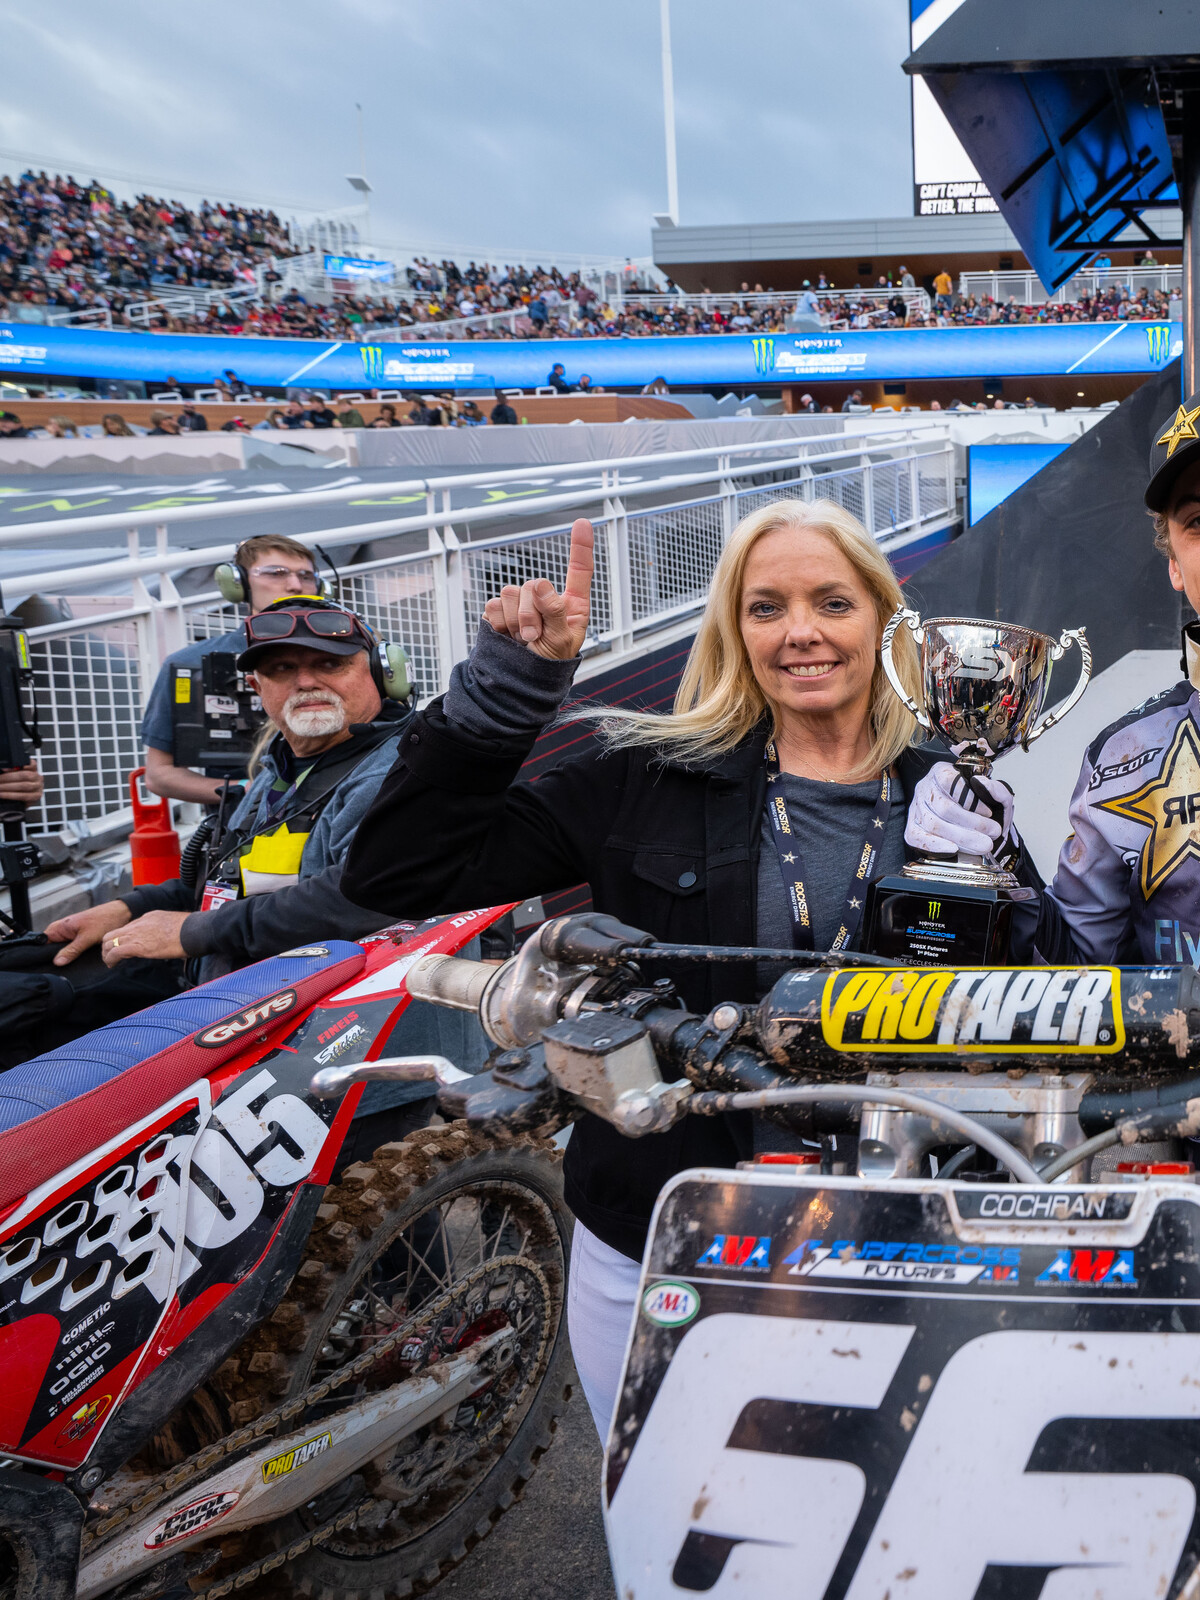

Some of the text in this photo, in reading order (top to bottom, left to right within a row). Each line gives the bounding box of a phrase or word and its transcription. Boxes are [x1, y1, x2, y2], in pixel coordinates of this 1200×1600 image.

[1104, 749, 1160, 777] SCOTT
[775, 797, 791, 836] ROCKSTAR
[856, 842, 873, 880] ROCKSTAR
[794, 881, 810, 928] ROCKSTAR
[927, 945, 949, 953] Futures
[202, 992, 294, 1042] GUTS
[317, 1010, 359, 1044] FINEIS
[980, 1193, 1107, 1218] COCHRAN
[697, 1234, 772, 1269] AMA
[1035, 1250, 1138, 1282] AMA
[863, 1263, 957, 1281] FUTURES
[978, 1266, 1019, 1281] AMA
[651, 1292, 688, 1311] AMA
[62, 1301, 111, 1345] COMETIC
[50, 1342, 112, 1395] OGIO
[164, 1493, 227, 1532] Pivot
